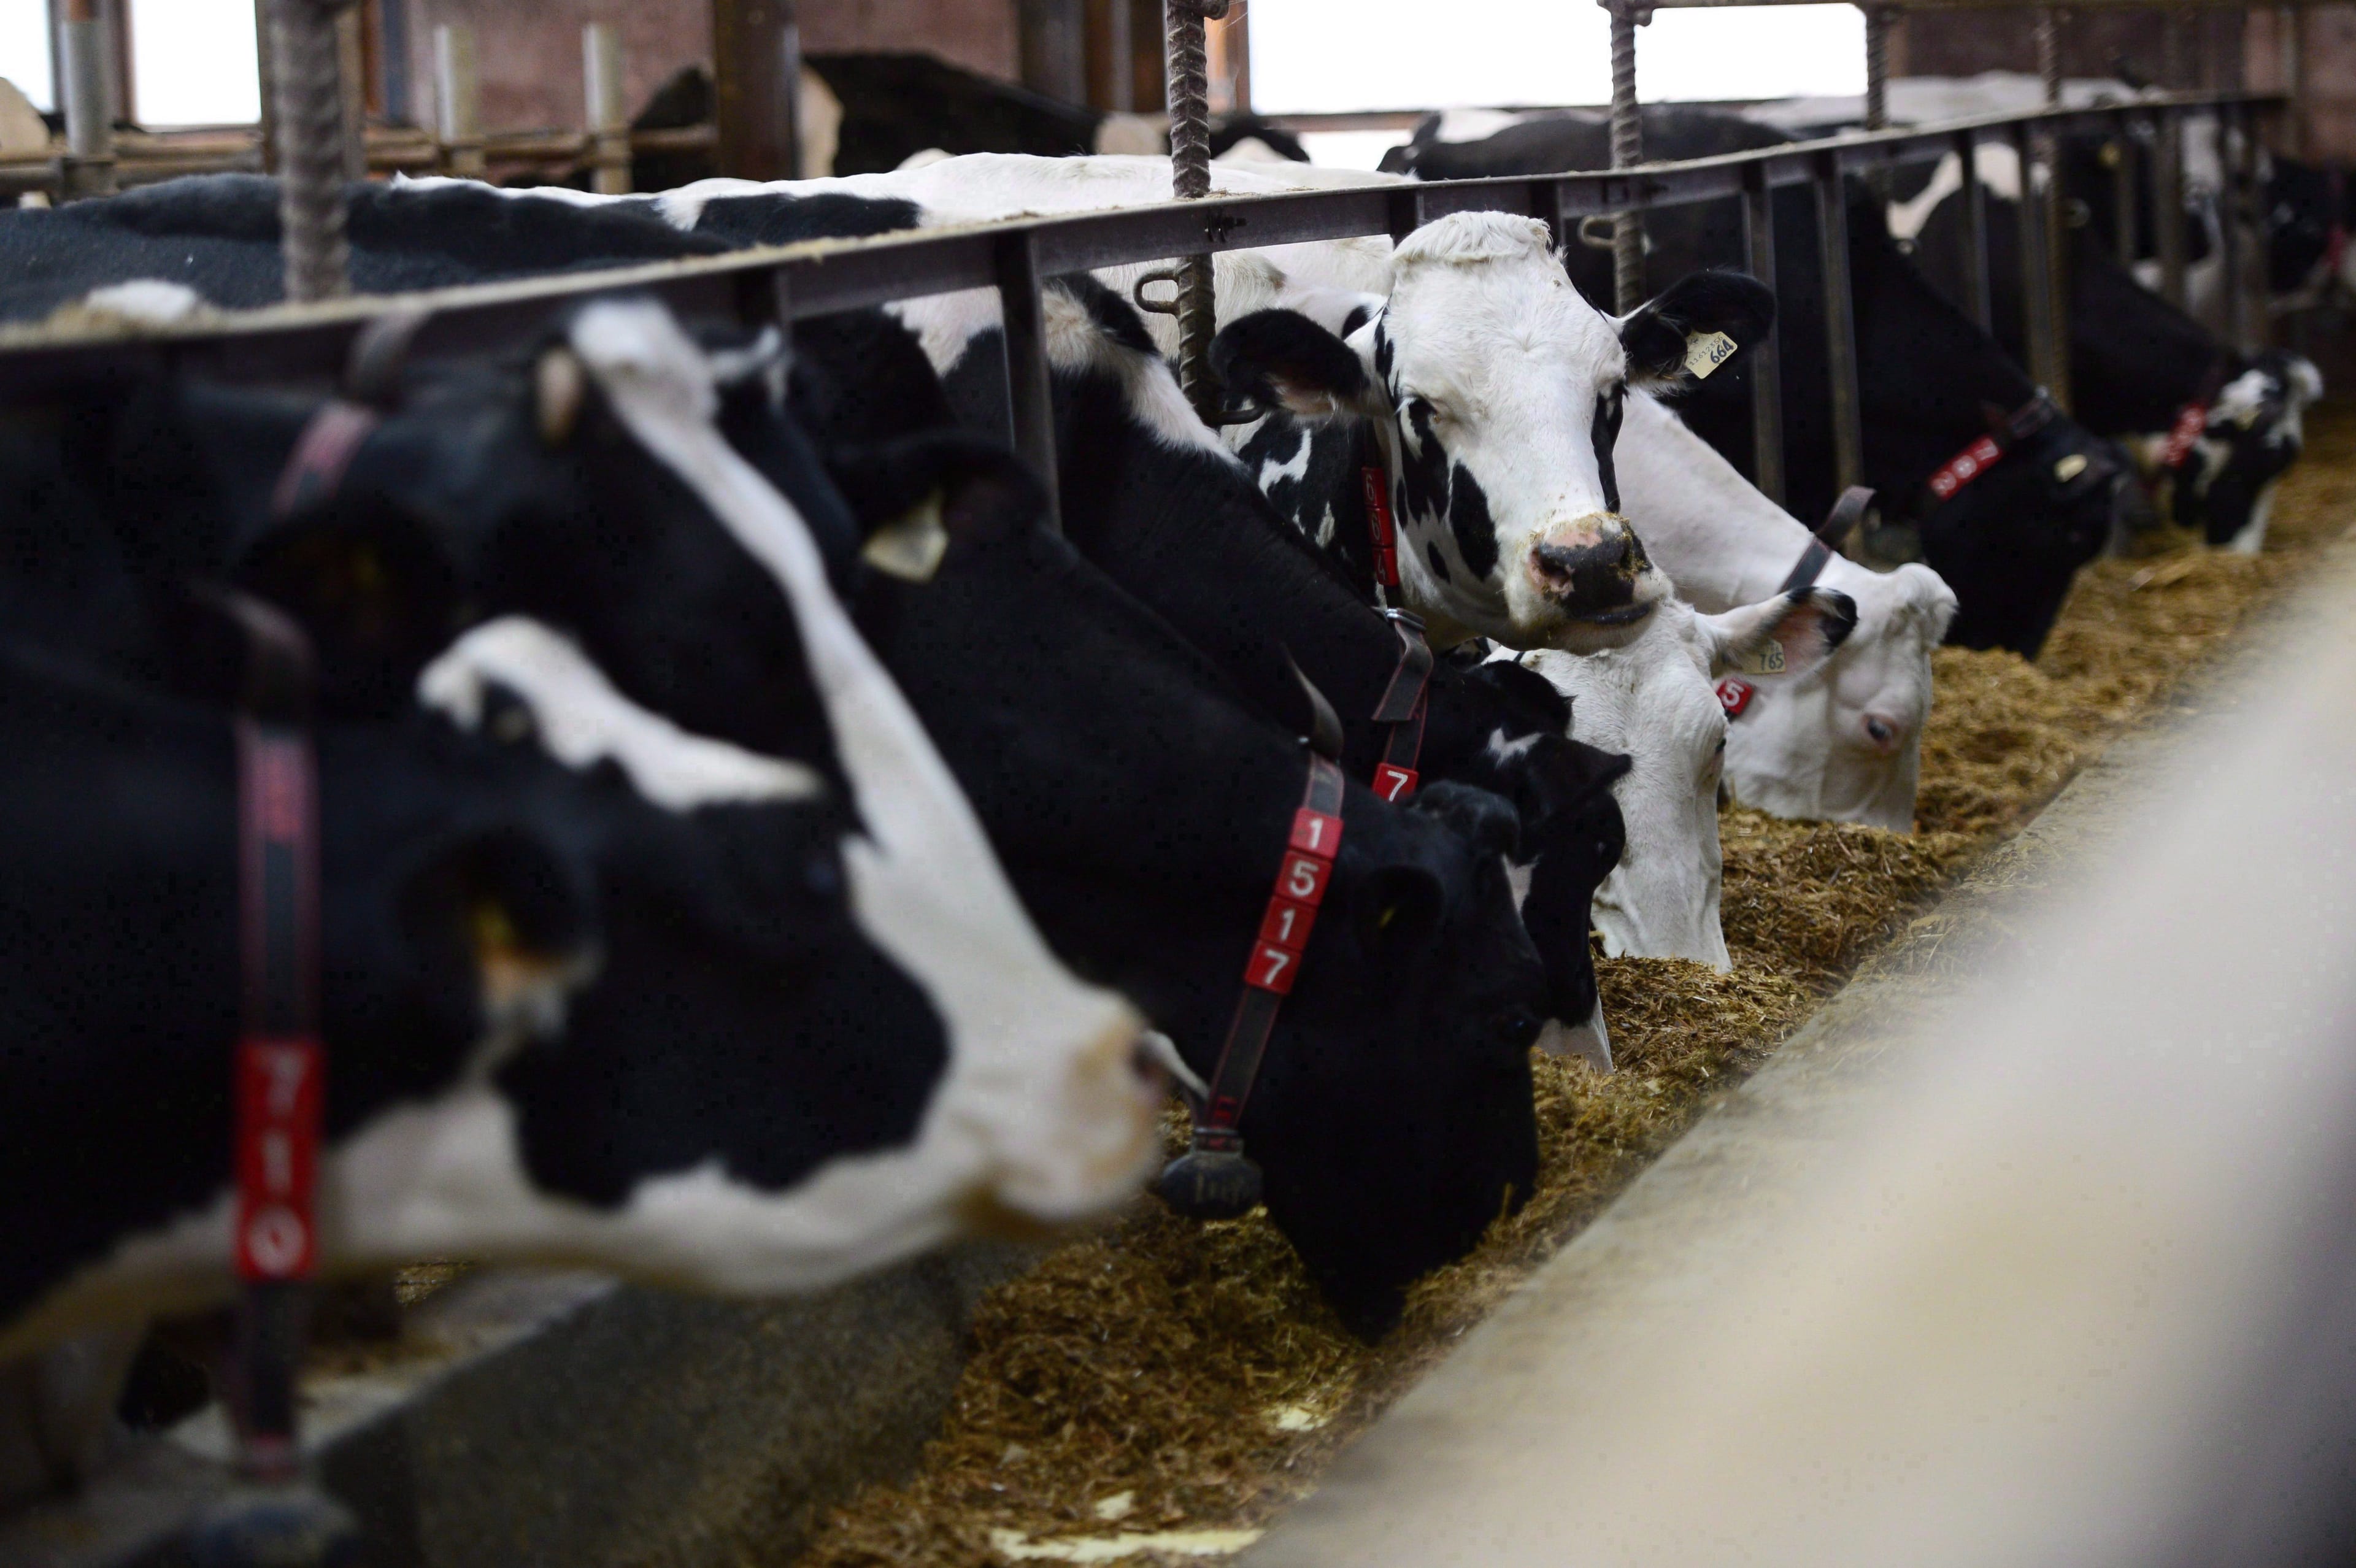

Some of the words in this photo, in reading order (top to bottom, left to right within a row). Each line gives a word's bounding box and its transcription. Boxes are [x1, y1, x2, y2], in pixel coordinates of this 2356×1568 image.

[1710, 338, 1734, 364] 664
[1759, 652, 1784, 671] 765
[1721, 682, 1744, 706] 5
[1387, 770, 1409, 802] 7
[1265, 818, 1324, 985] 1517
